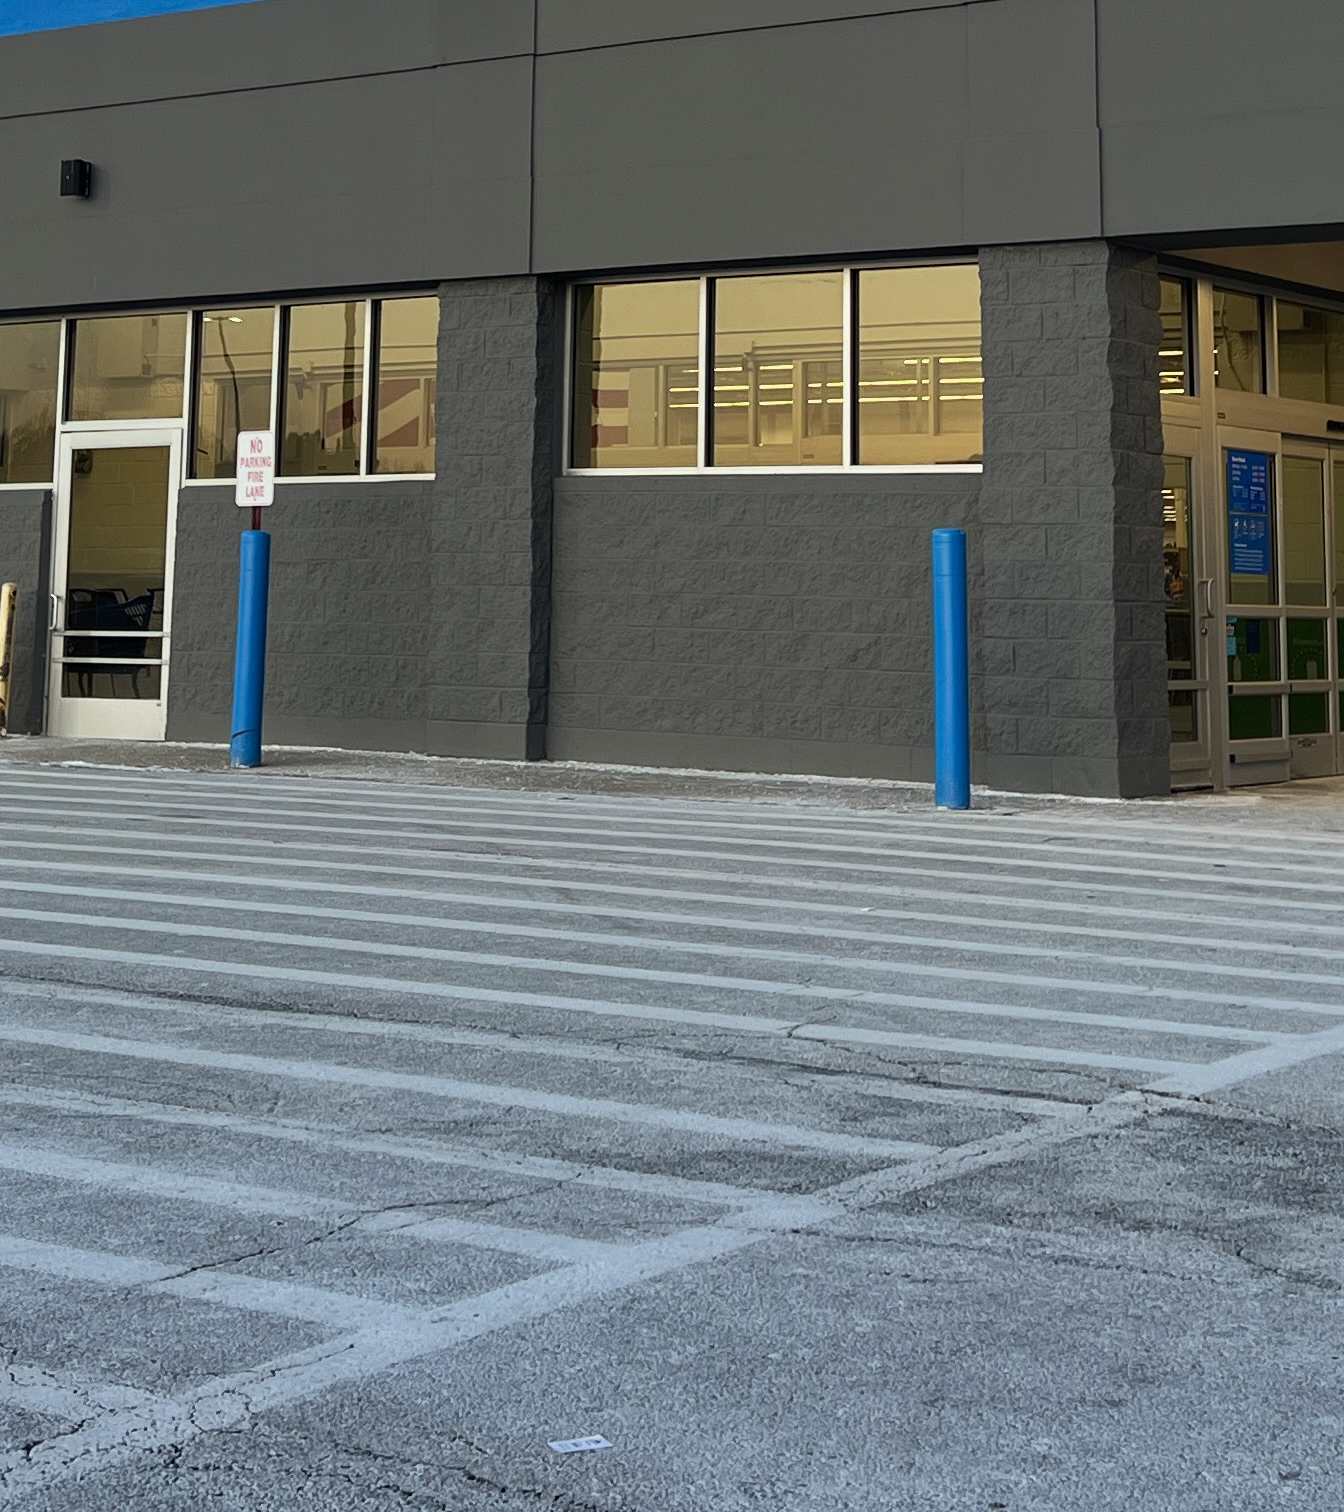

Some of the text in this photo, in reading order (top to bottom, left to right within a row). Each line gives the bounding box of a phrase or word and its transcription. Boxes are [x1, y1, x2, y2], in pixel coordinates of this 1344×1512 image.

[249, 439, 263, 454] NO
[240, 456, 272, 468] PARKING
[247, 471, 264, 483] FIRE
[245, 485, 265, 498] LANE
